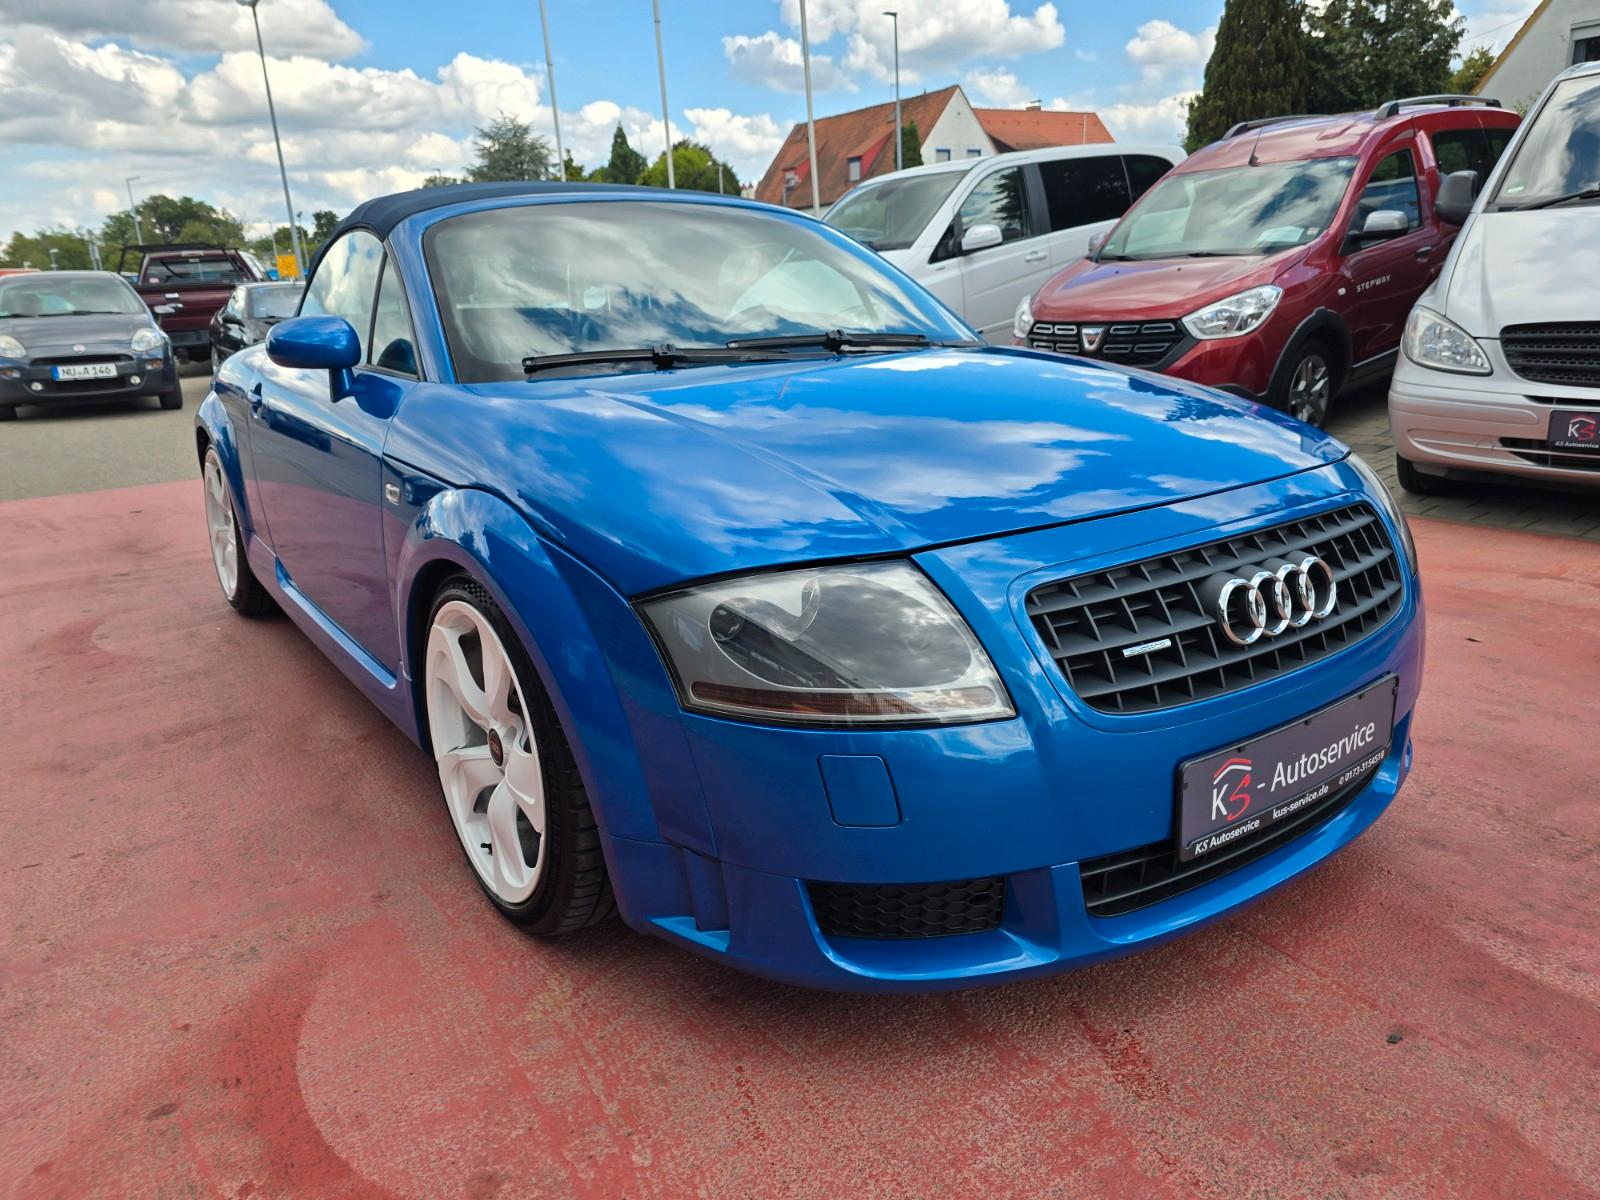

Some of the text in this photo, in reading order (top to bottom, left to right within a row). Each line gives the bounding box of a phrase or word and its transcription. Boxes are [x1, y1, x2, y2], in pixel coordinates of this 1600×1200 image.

[1356, 274, 1391, 293] STEPWAY
[92, 365, 112, 377] 146
[1270, 721, 1375, 792] Autoservice
[1194, 839, 1209, 856] KS
[1209, 819, 1260, 849] Autoservice
[1272, 784, 1329, 820] kus-service.de
